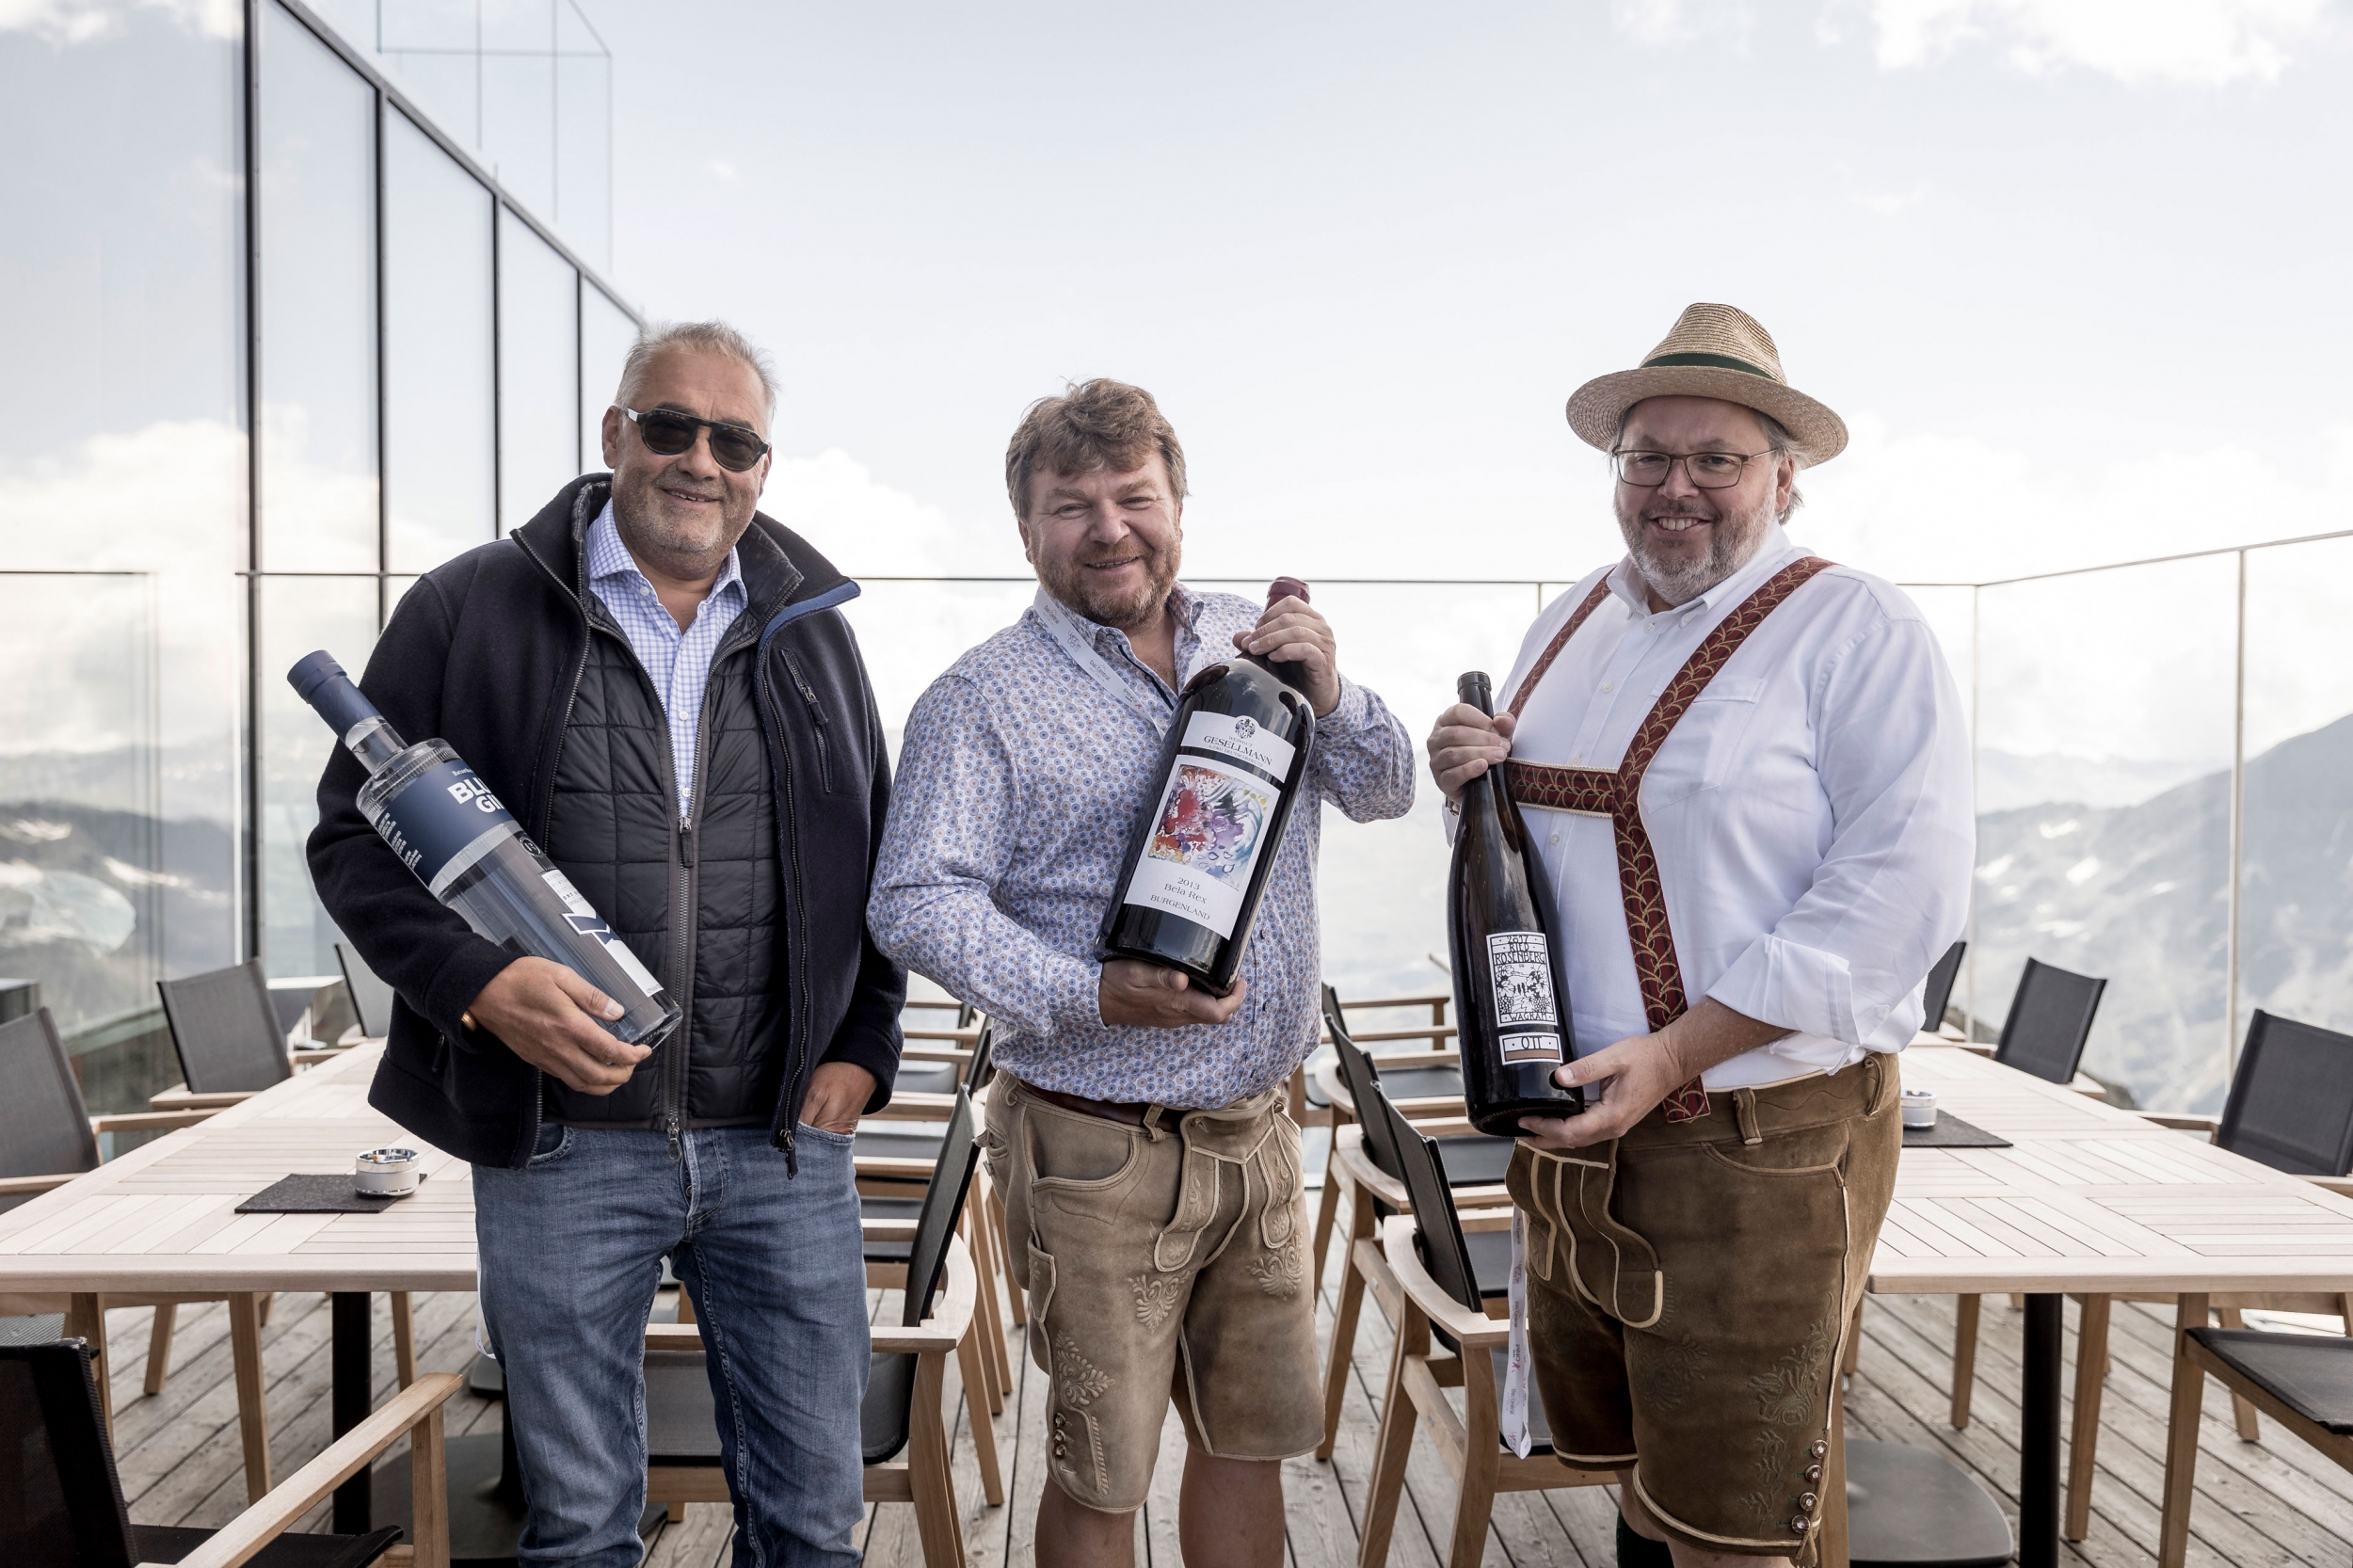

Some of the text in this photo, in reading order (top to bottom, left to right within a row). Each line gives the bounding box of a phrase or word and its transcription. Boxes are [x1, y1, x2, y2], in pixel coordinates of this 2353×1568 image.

[1204, 735, 1273, 765] GESELLMANN
[447, 776, 492, 805] BLU
[1177, 877, 1200, 890] 2013
[1163, 883, 1208, 904] Bela Rex
[1150, 894, 1210, 920] BURGENLAND
[1510, 942, 1529, 952] RIED
[1495, 951, 1546, 966] ROSENBERG
[1509, 1011, 1546, 1022] WAGRAM
[1521, 1035, 1543, 1050] OTT
